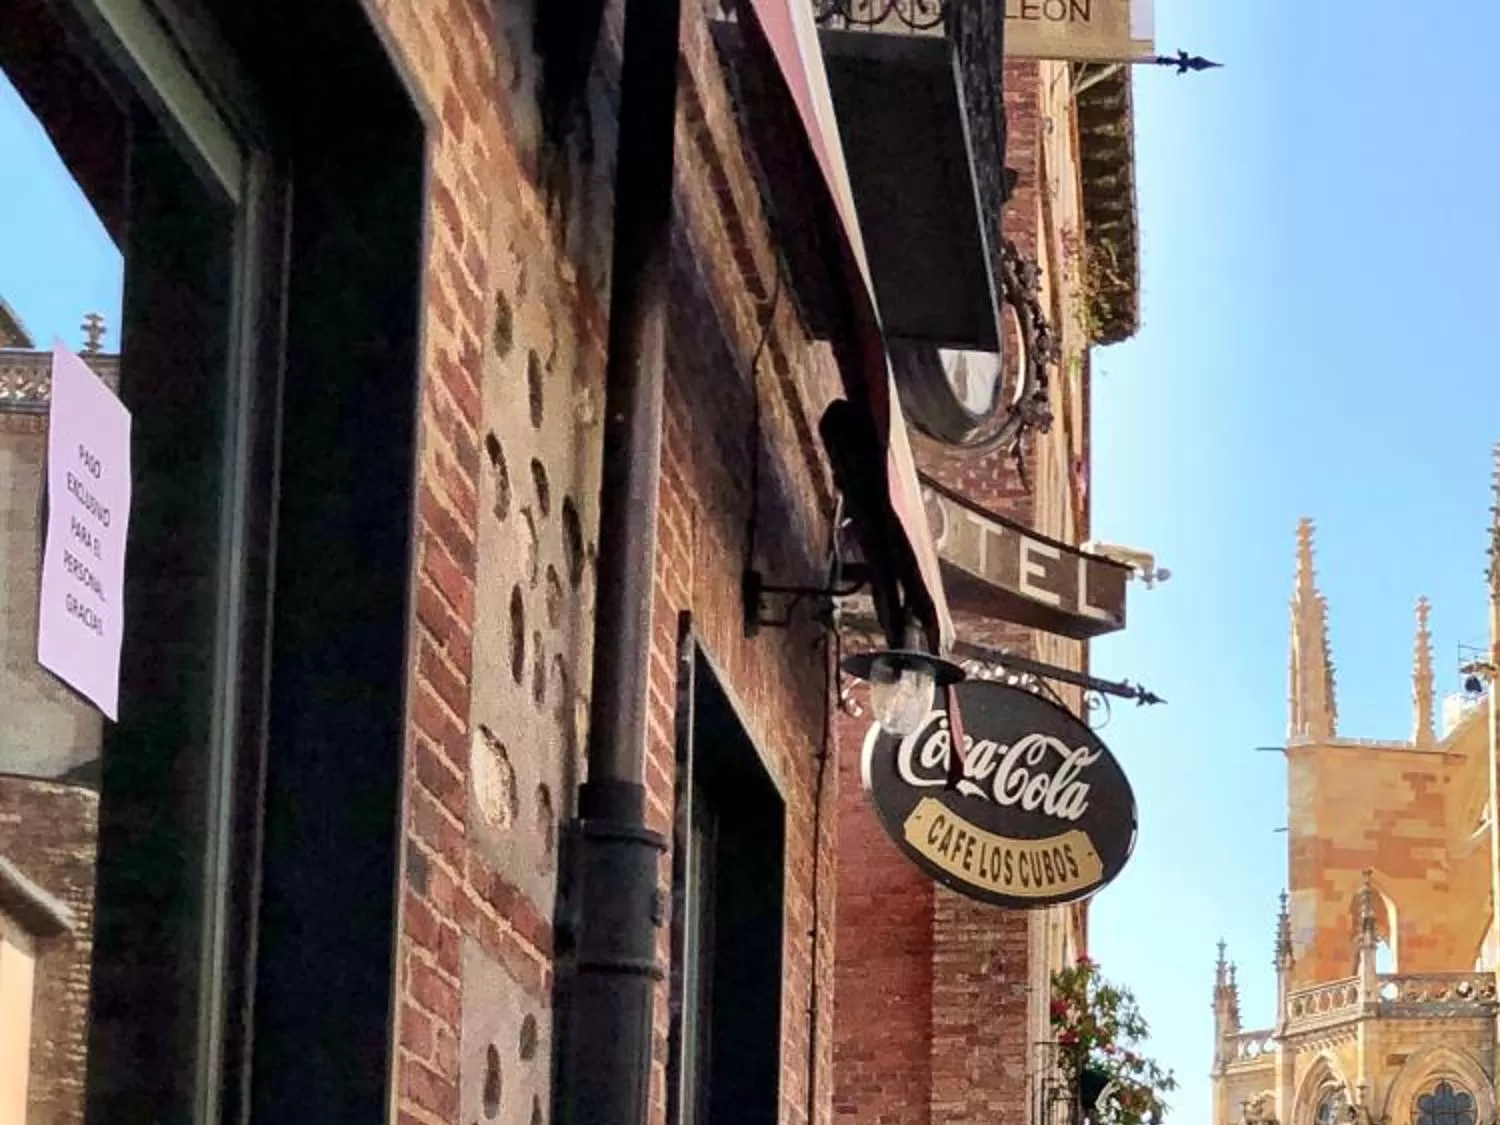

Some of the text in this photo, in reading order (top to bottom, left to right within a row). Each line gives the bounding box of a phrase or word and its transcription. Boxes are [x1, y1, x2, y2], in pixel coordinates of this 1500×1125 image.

[79, 443, 101, 479] PASO
[67, 470, 110, 528] EXCLUSIVO
[71, 514, 103, 561] PARA EL
[924, 488, 1111, 622] OTEL
[63, 547, 106, 604] PERSONAL
[65, 592, 103, 637] GRACIAS
[927, 814, 1080, 888] CAFE LOS CUBOS
